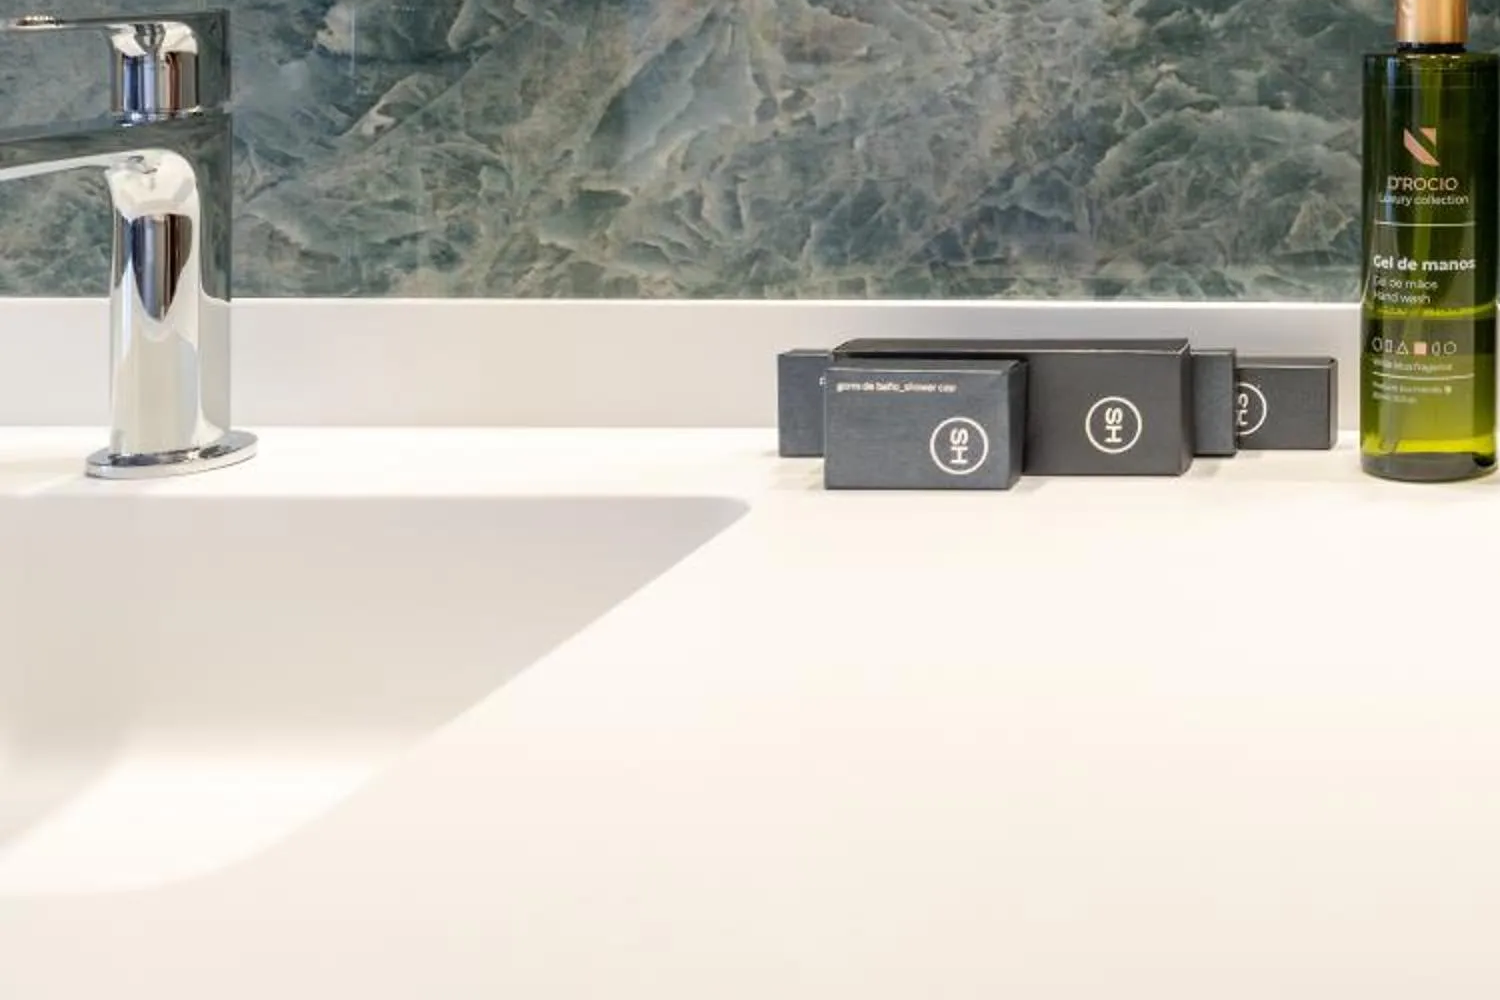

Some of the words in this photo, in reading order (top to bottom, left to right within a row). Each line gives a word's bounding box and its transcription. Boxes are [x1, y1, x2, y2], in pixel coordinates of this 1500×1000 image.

[1387, 176, 1459, 191] D'ROCIO
[1373, 255, 1393, 269] Gel
[1397, 257, 1417, 271] de
[1421, 259, 1476, 271] manos
[1104, 406, 1123, 443] HS
[949, 427, 969, 465] HS
